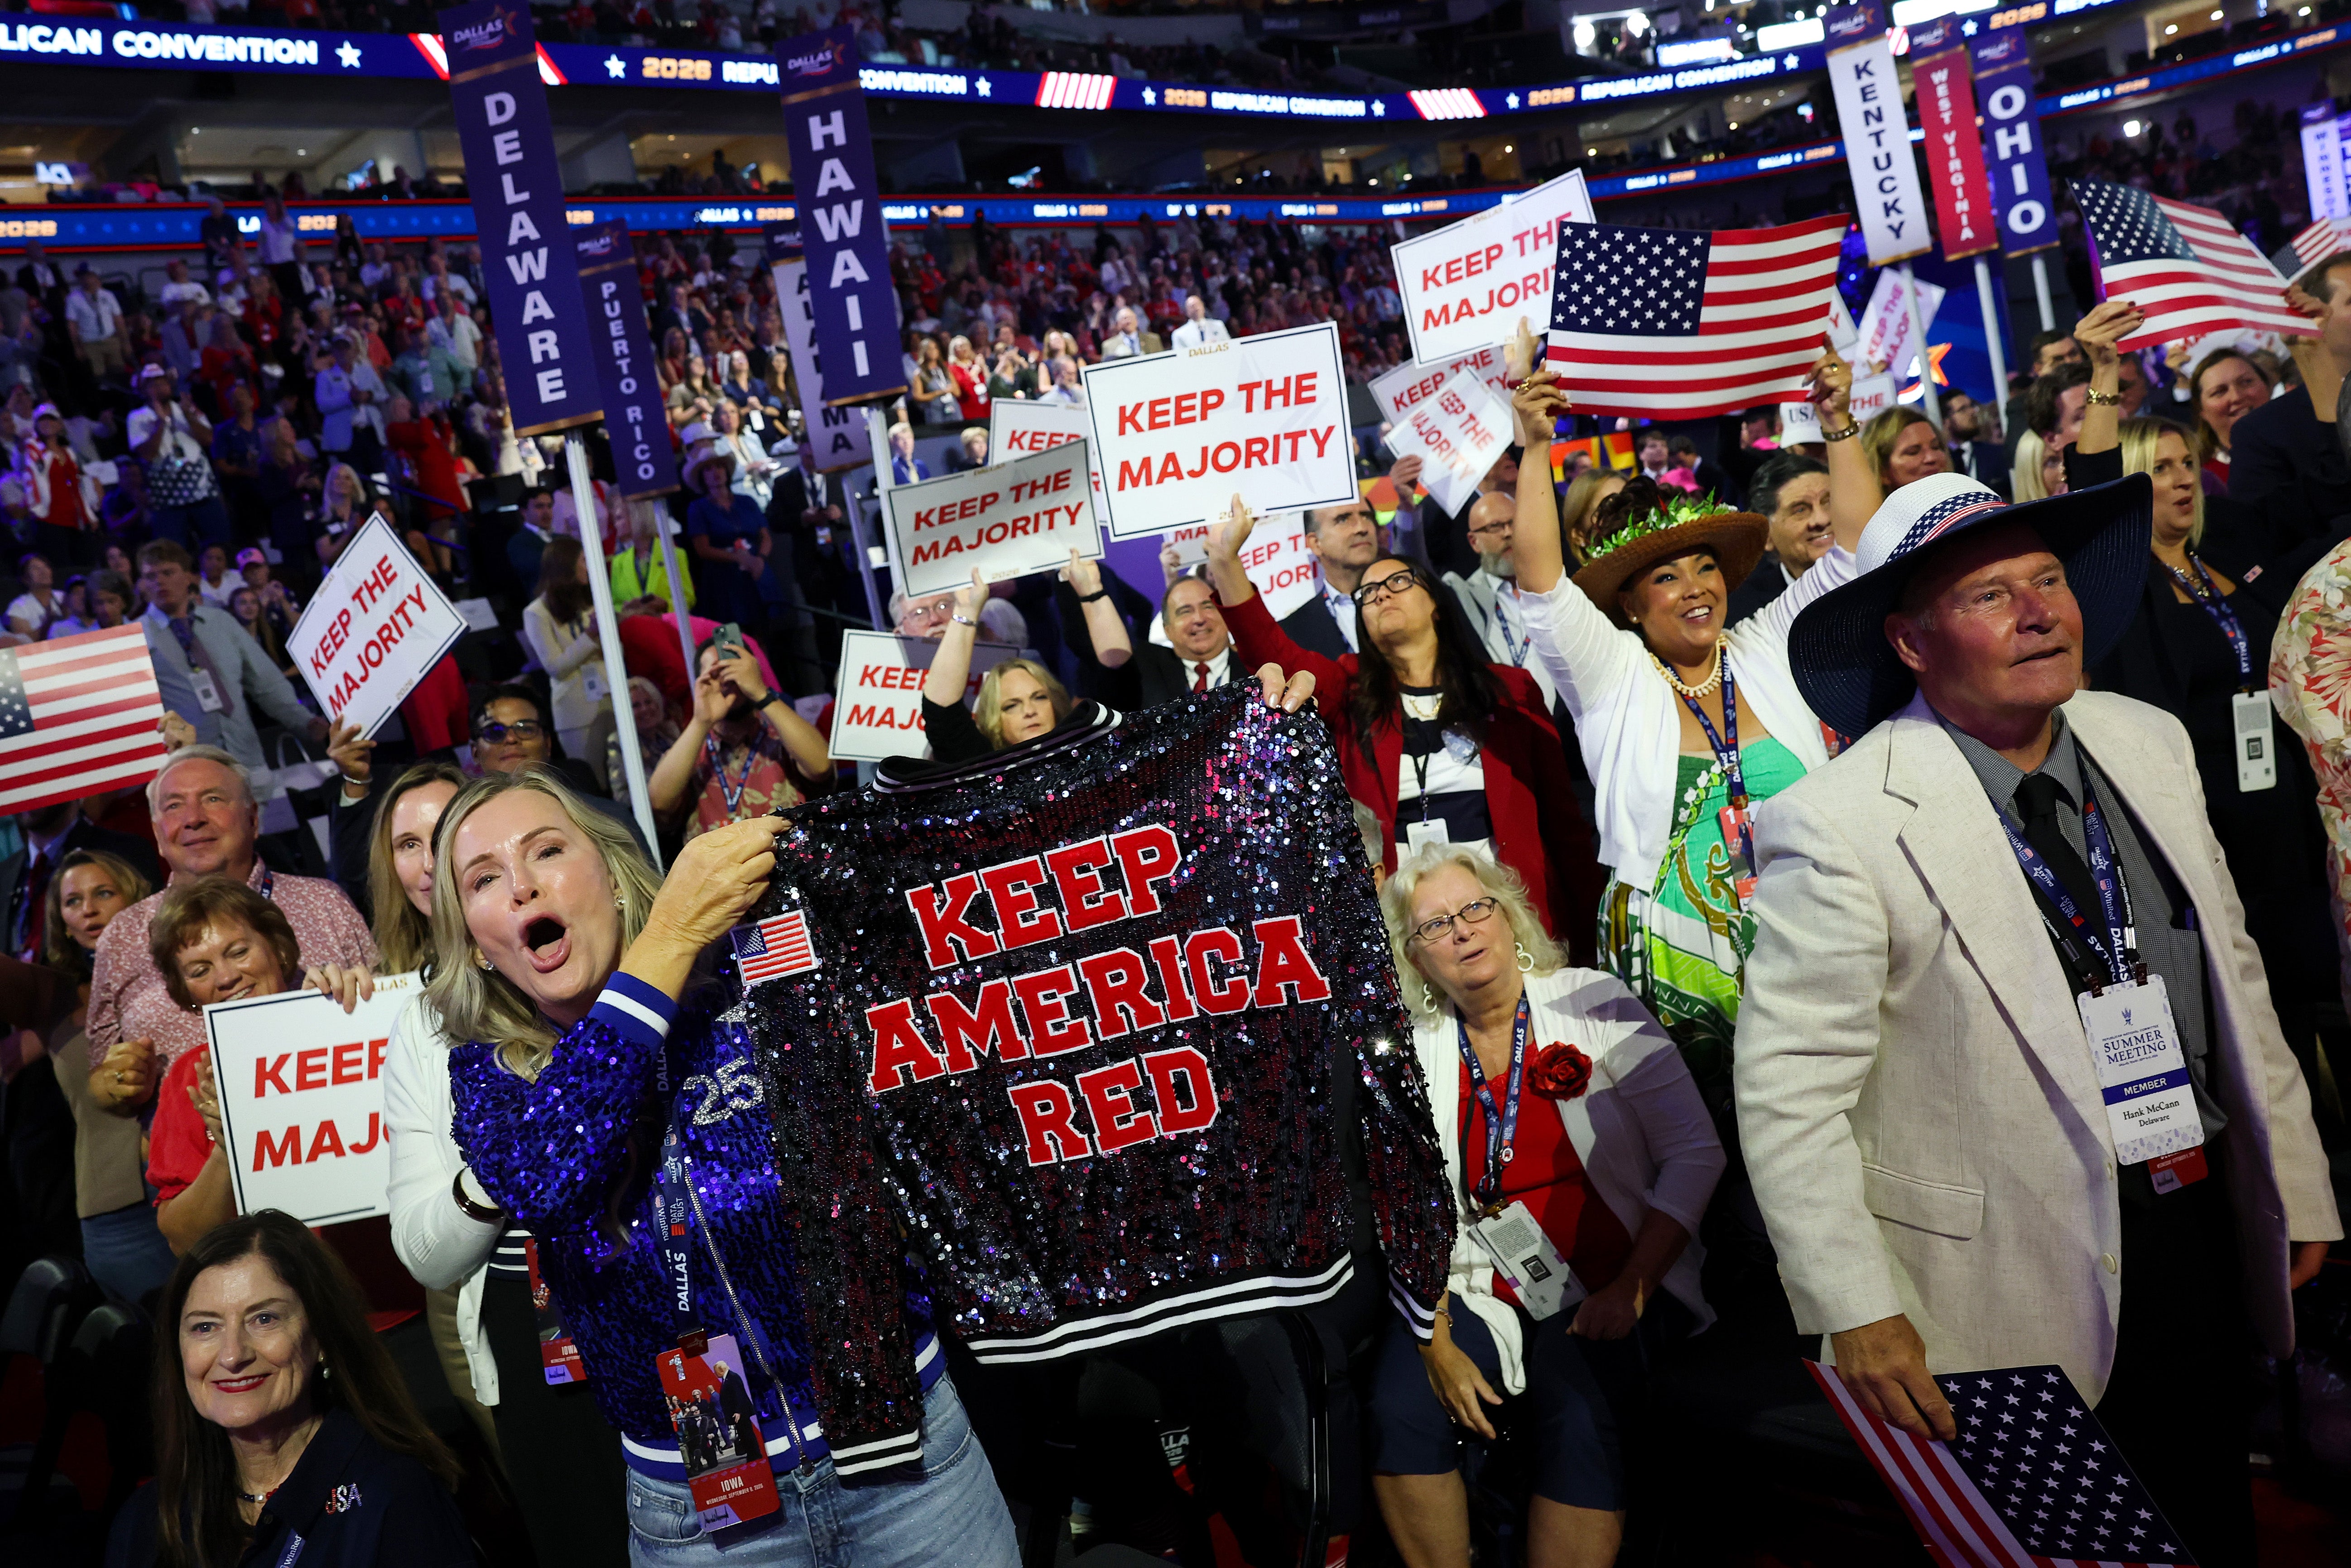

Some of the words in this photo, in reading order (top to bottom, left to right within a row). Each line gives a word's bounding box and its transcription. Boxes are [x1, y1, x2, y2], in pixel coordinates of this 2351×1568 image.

[453, 18, 503, 43] DALLAS
[112, 30, 318, 65] CONVENTION
[787, 49, 833, 70] DALLAS
[642, 57, 712, 81] 2026
[722, 61, 779, 85] REPU
[1581, 73, 1673, 101] REPUBLICAN
[1675, 57, 1775, 88] CONVENTION
[1211, 91, 1288, 113] REPUBLICAN
[1289, 97, 1365, 116] CONVENTION
[1853, 59, 1905, 240] KENTUCKY
[1930, 67, 1953, 125] WEST
[1942, 130, 1975, 241] VIRGINIA
[1988, 84, 2046, 235] OHIO
[484, 92, 567, 404] DELAWARE
[808, 110, 870, 376] HAWAII
[1422, 243, 1504, 293] KEEP
[1422, 265, 1557, 332] MAJORI
[797, 273, 854, 453] ALMA
[1188, 342, 1230, 358] DALLAS
[601, 281, 637, 394] PUERTO
[626, 406, 656, 481] RICO
[1392, 371, 1446, 413] KEEP
[1118, 389, 1225, 436] KEEP
[1237, 371, 1318, 414] THE
[1851, 393, 1883, 411] THE
[1459, 413, 1495, 452] THE
[1117, 425, 1336, 492] MAJORITY
[913, 492, 1000, 531] KEEP
[1010, 469, 1072, 503] THE
[1219, 507, 1253, 521] 206
[912, 501, 1084, 567] MAJORITY
[1237, 541, 1281, 570] EEP
[1264, 561, 1318, 595] JORI
[310, 608, 352, 679] KEEP
[351, 554, 399, 615] THE
[328, 583, 428, 717] MAJORITY
[1728, 750, 1741, 783] DAAS
[1725, 808, 1735, 825] 1
[2085, 815, 2095, 835] TRUST
[2090, 812, 2099, 831] DATA
[2095, 846, 2103, 866] DALLAS
[2116, 865, 2126, 886] Committee
[905, 823, 1181, 970] KEEP
[2060, 895, 2077, 914] TRUST
[2060, 901, 2074, 918] DATA
[2104, 890, 2115, 922] WinRed
[2121, 886, 2129, 903] National
[2043, 918, 2061, 939] Committee
[2110, 927, 2129, 982] DALLAS
[865, 914, 1332, 1095] AMERICA
[1514, 1027, 1525, 1064] DALLAS
[2104, 1029, 2164, 1053] SUMMER
[2106, 1040, 2167, 1065] MEETING
[657, 1045, 669, 1092] DALLA
[1462, 1047, 1482, 1079] DLLAS
[682, 1056, 764, 1126] 25
[2123, 1077, 2167, 1097] MEMBER
[1007, 1045, 1219, 1167] RED
[2123, 1109, 2144, 1121] Hank
[2146, 1100, 2180, 1112] McCann
[2138, 1114, 2170, 1127] Delaware
[252, 1112, 390, 1173] MAJ
[676, 1198, 685, 1223] TRUST
[673, 1252, 690, 1312] DALLAS
[561, 1344, 578, 1356] IOWA
[668, 1354, 686, 1381] 1
[1161, 1433, 1190, 1451] LLA
[325, 1483, 362, 1515] USA
[720, 1476, 744, 1493] IOWA
[728, 1487, 750, 1499] SEPTEMBER
[283, 1534, 302, 1566] WinRed
